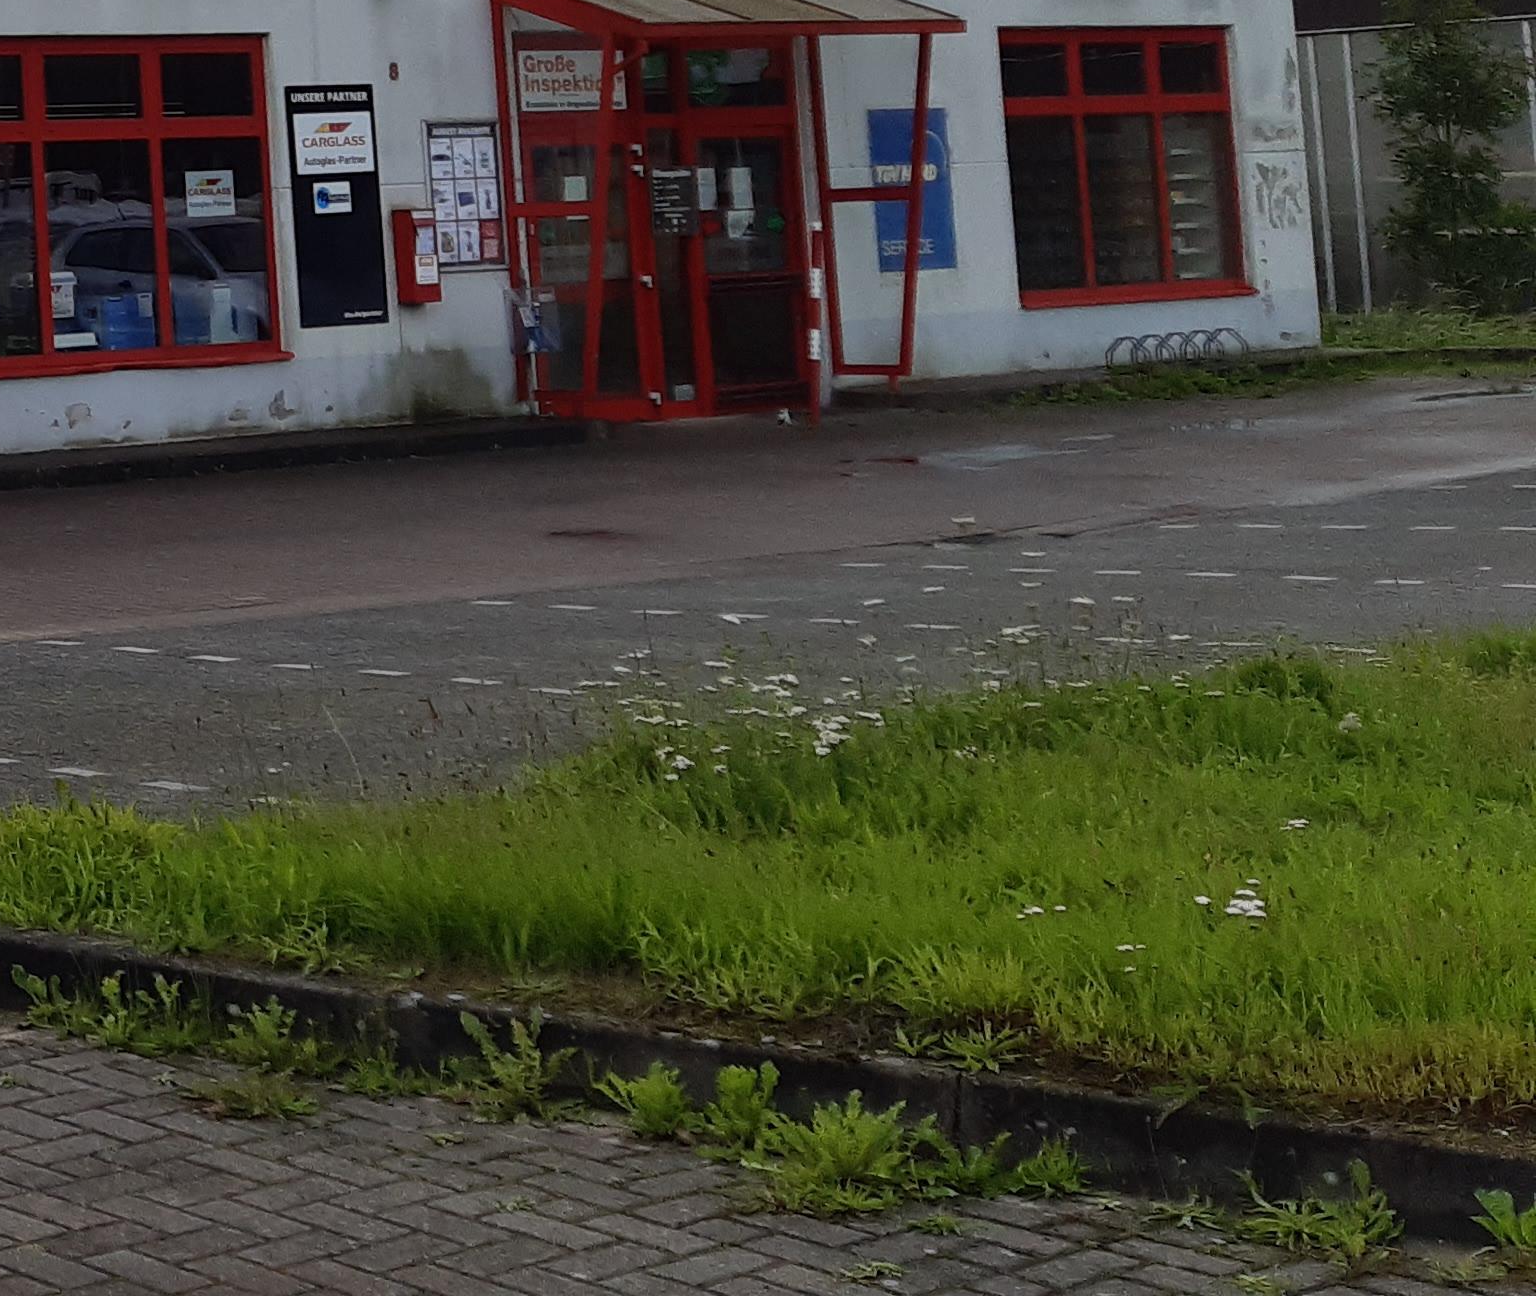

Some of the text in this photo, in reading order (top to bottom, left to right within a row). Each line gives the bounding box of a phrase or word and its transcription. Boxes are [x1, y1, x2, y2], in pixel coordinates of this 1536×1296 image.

[523, 55, 576, 73] Große
[524, 74, 604, 96] Inspektio
[290, 91, 368, 103] UNSERE PARTNER
[302, 136, 366, 148] CARGLASS
[304, 156, 367, 167] Autoglas-Partner
